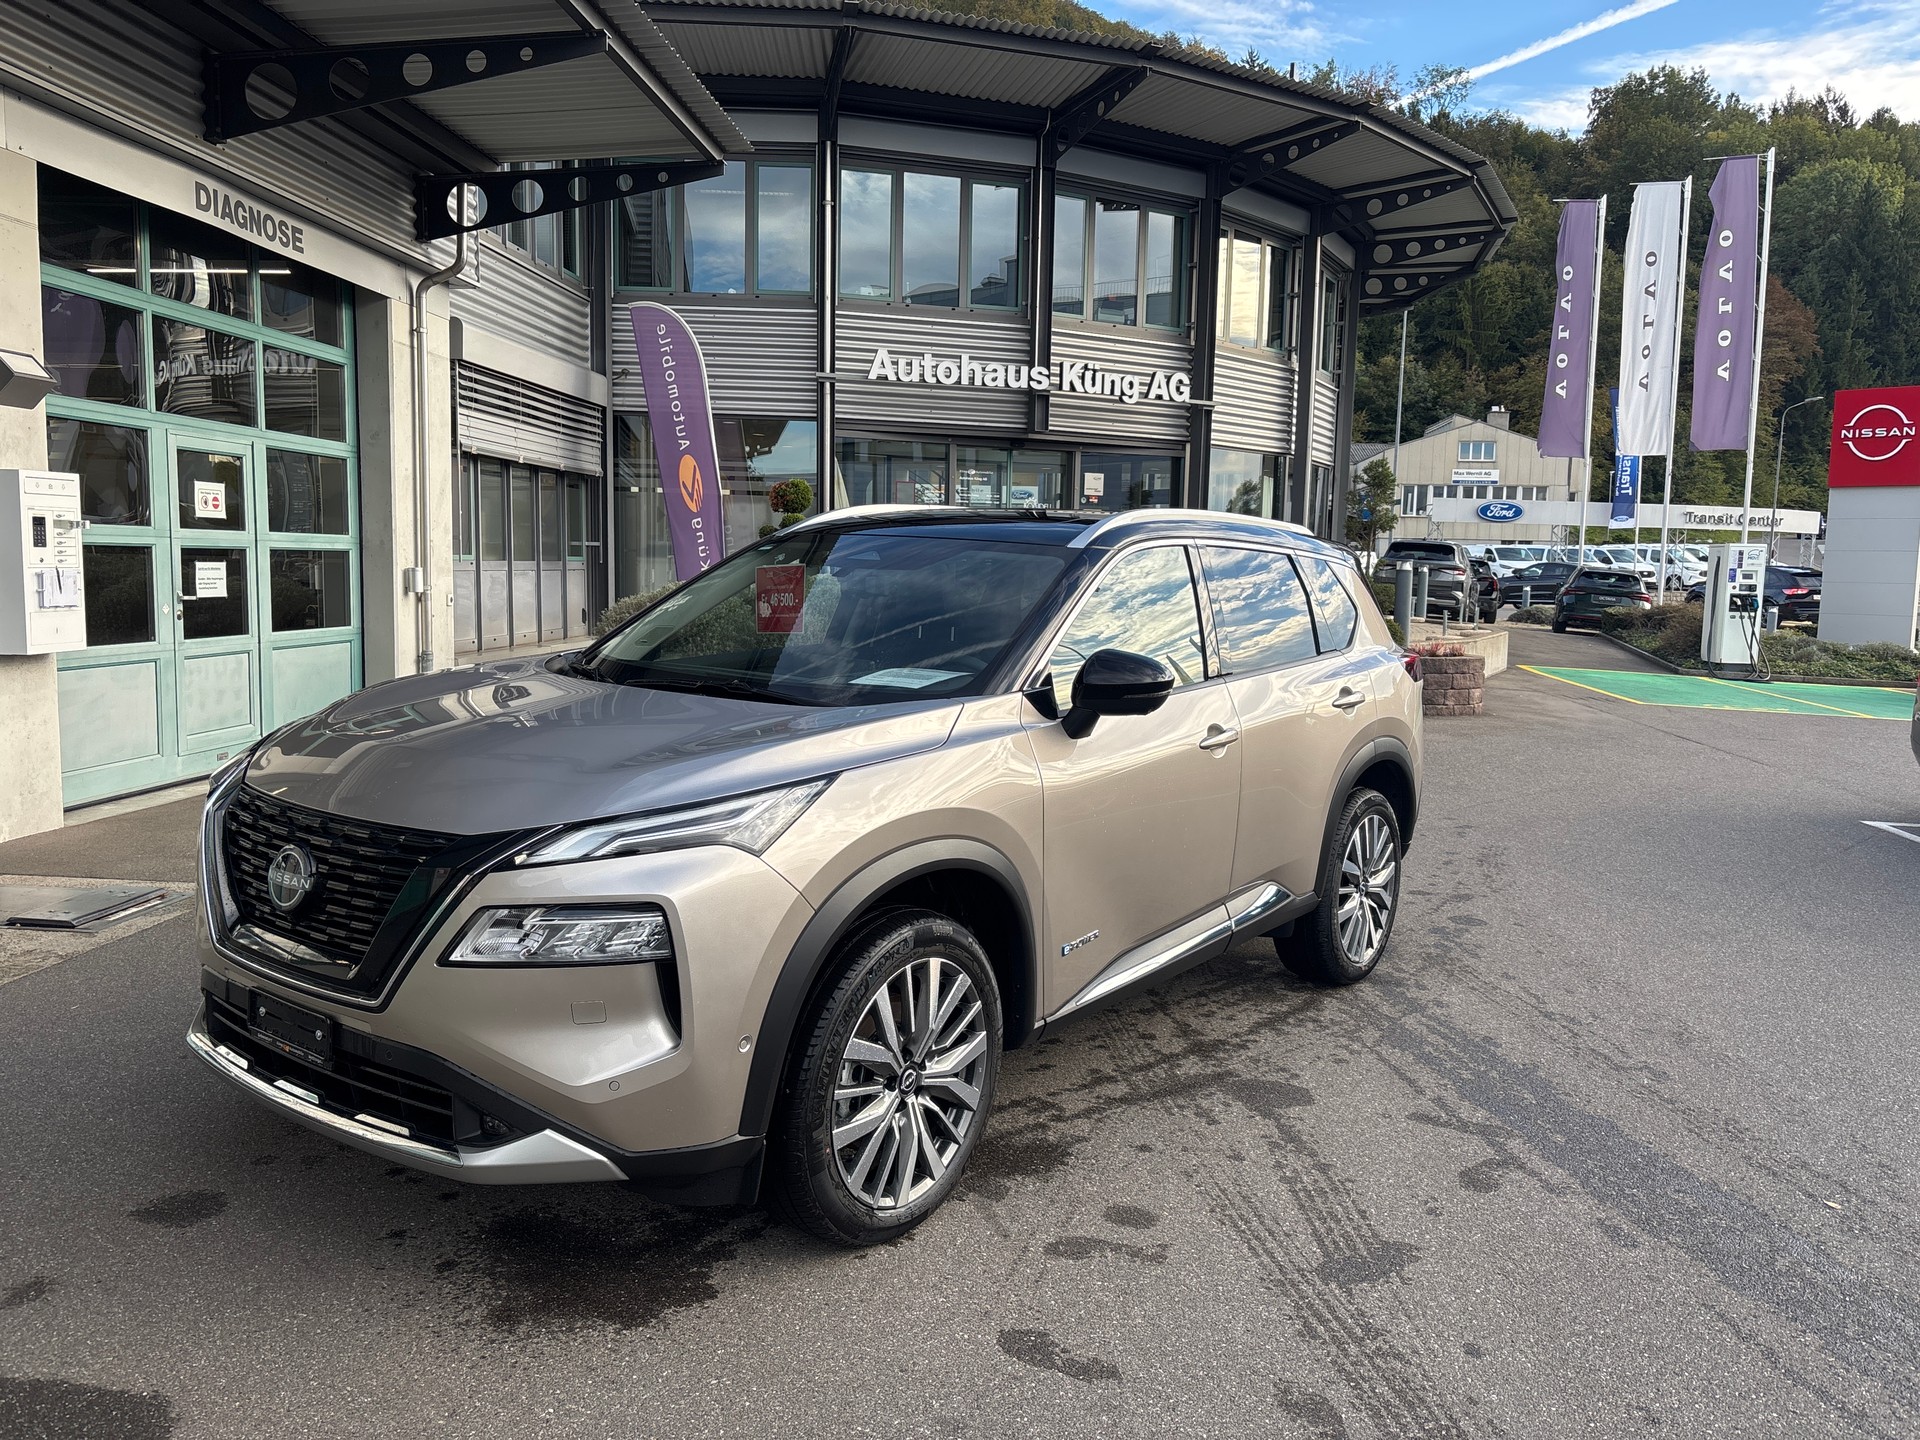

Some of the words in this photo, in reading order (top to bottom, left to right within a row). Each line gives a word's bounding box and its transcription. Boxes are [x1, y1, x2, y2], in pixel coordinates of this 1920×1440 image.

[194, 180, 305, 254] DIAGNOSE
[867, 349, 1050, 391] Autohaus
[1060, 361, 1140, 404] Küng
[1147, 371, 1191, 402] AG
[1841, 426, 1916, 439] NISSAN
[1486, 503, 1516, 518] Ford
[1683, 511, 1734, 526] Transit
